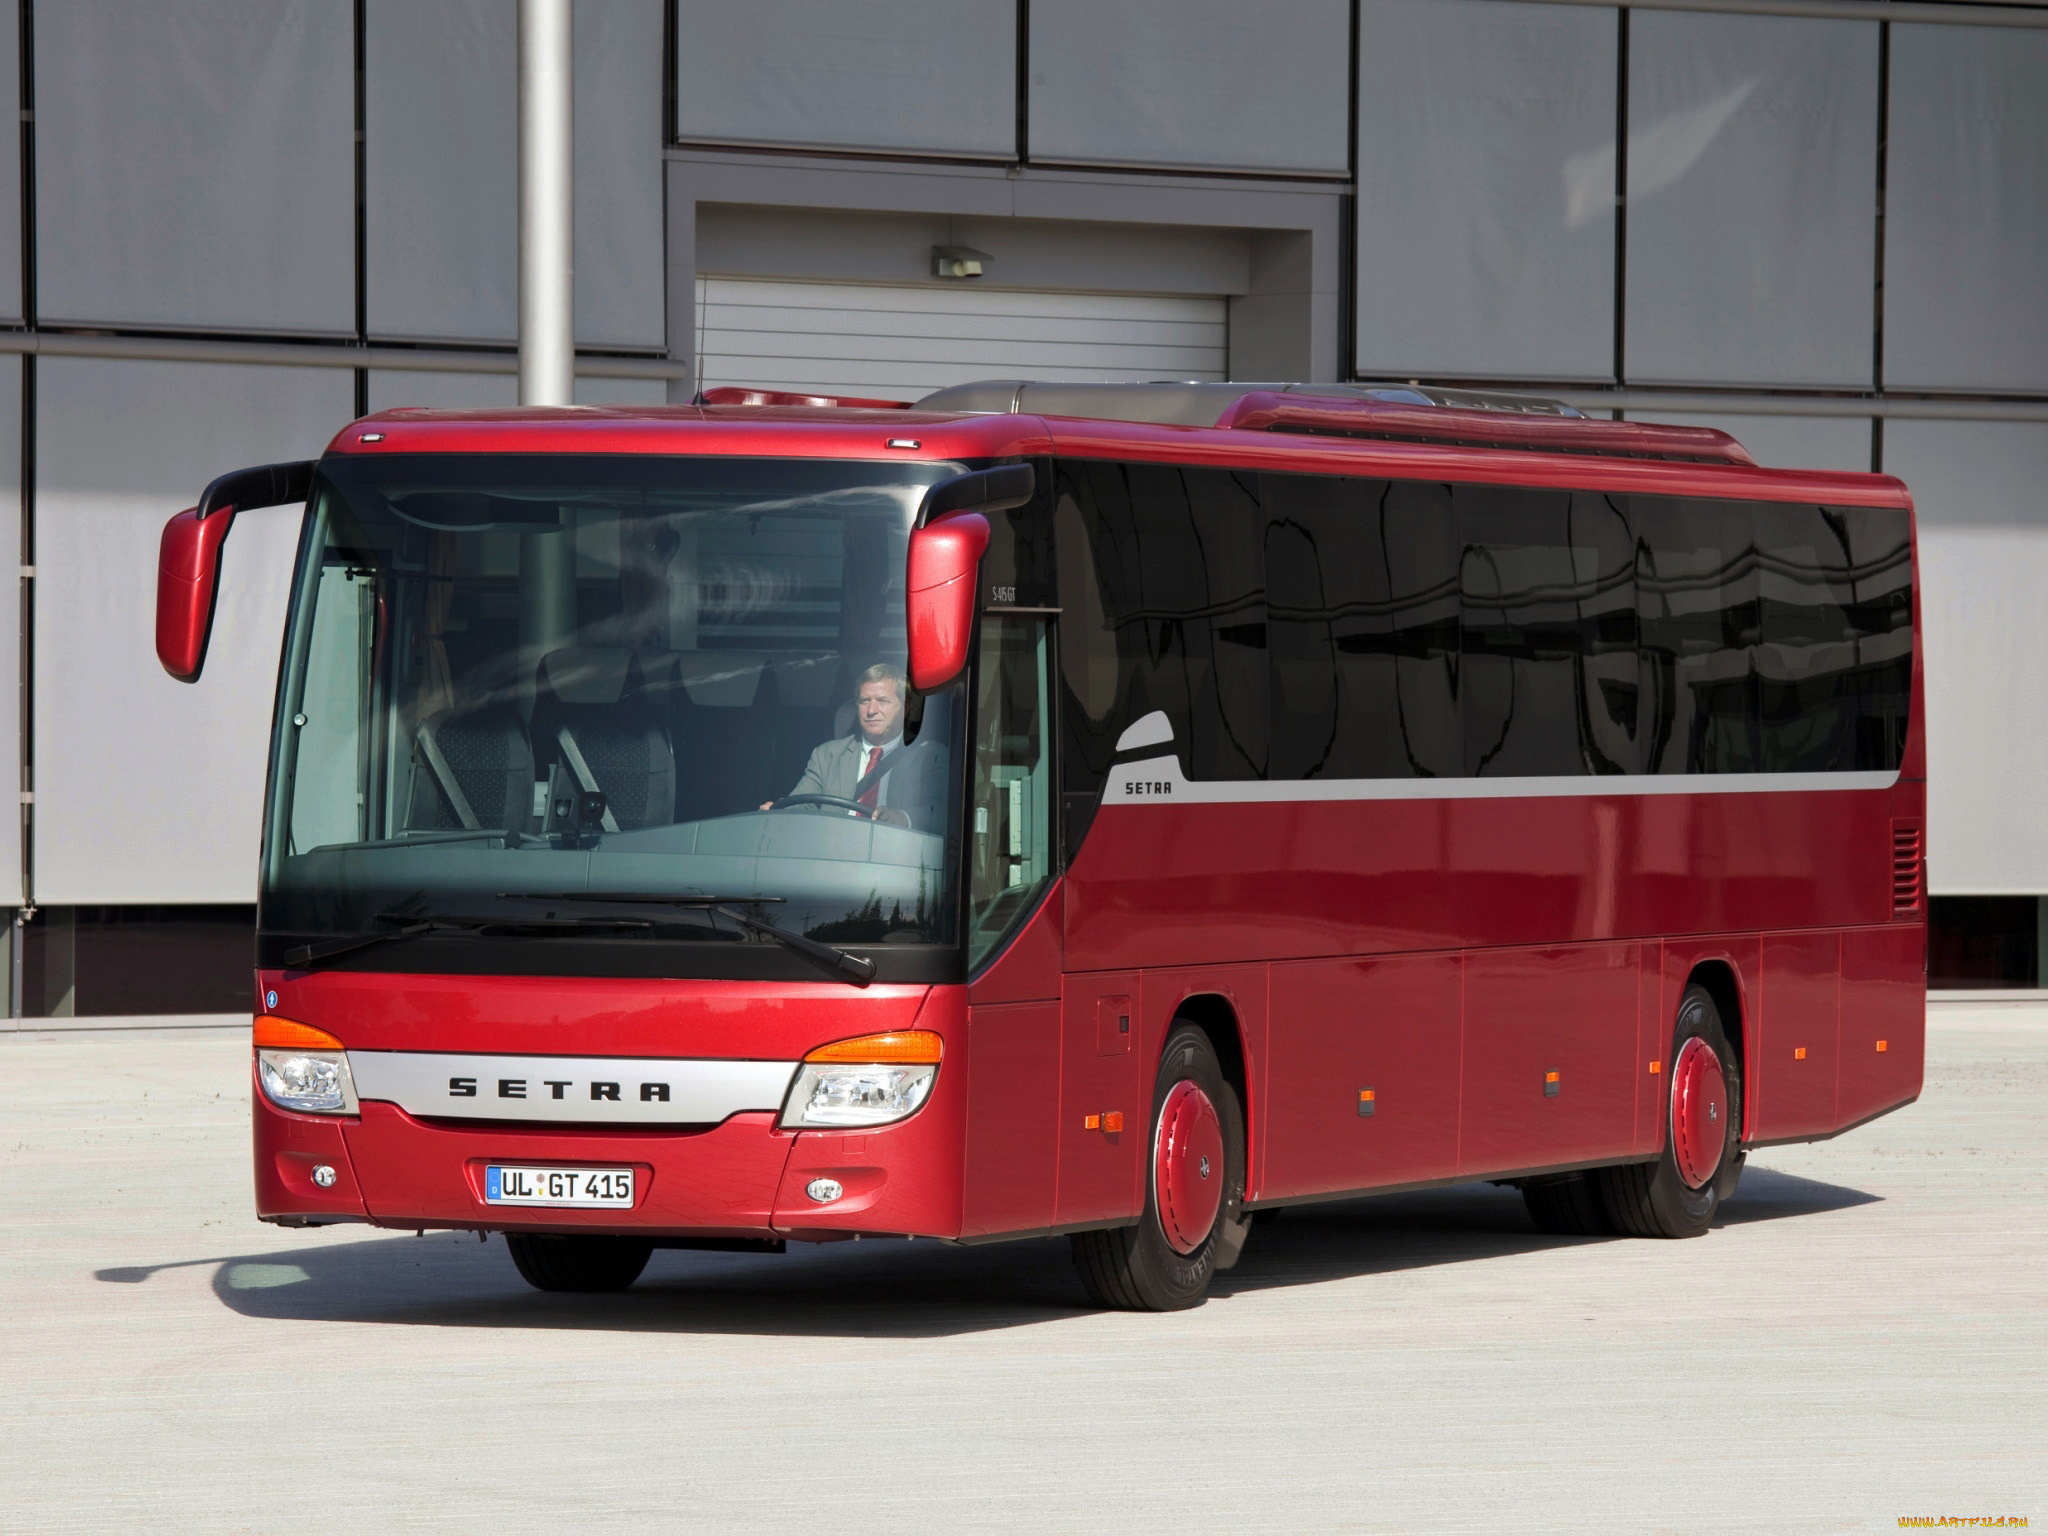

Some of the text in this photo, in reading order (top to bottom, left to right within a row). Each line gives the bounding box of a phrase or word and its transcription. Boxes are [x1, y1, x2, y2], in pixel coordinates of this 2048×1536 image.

[1007, 586, 1016, 602] GT
[1125, 781, 1172, 795] SETRA
[449, 1077, 671, 1102] SETRA
[491, 1186, 498, 1195] D
[502, 1171, 630, 1200] UL GT 415
